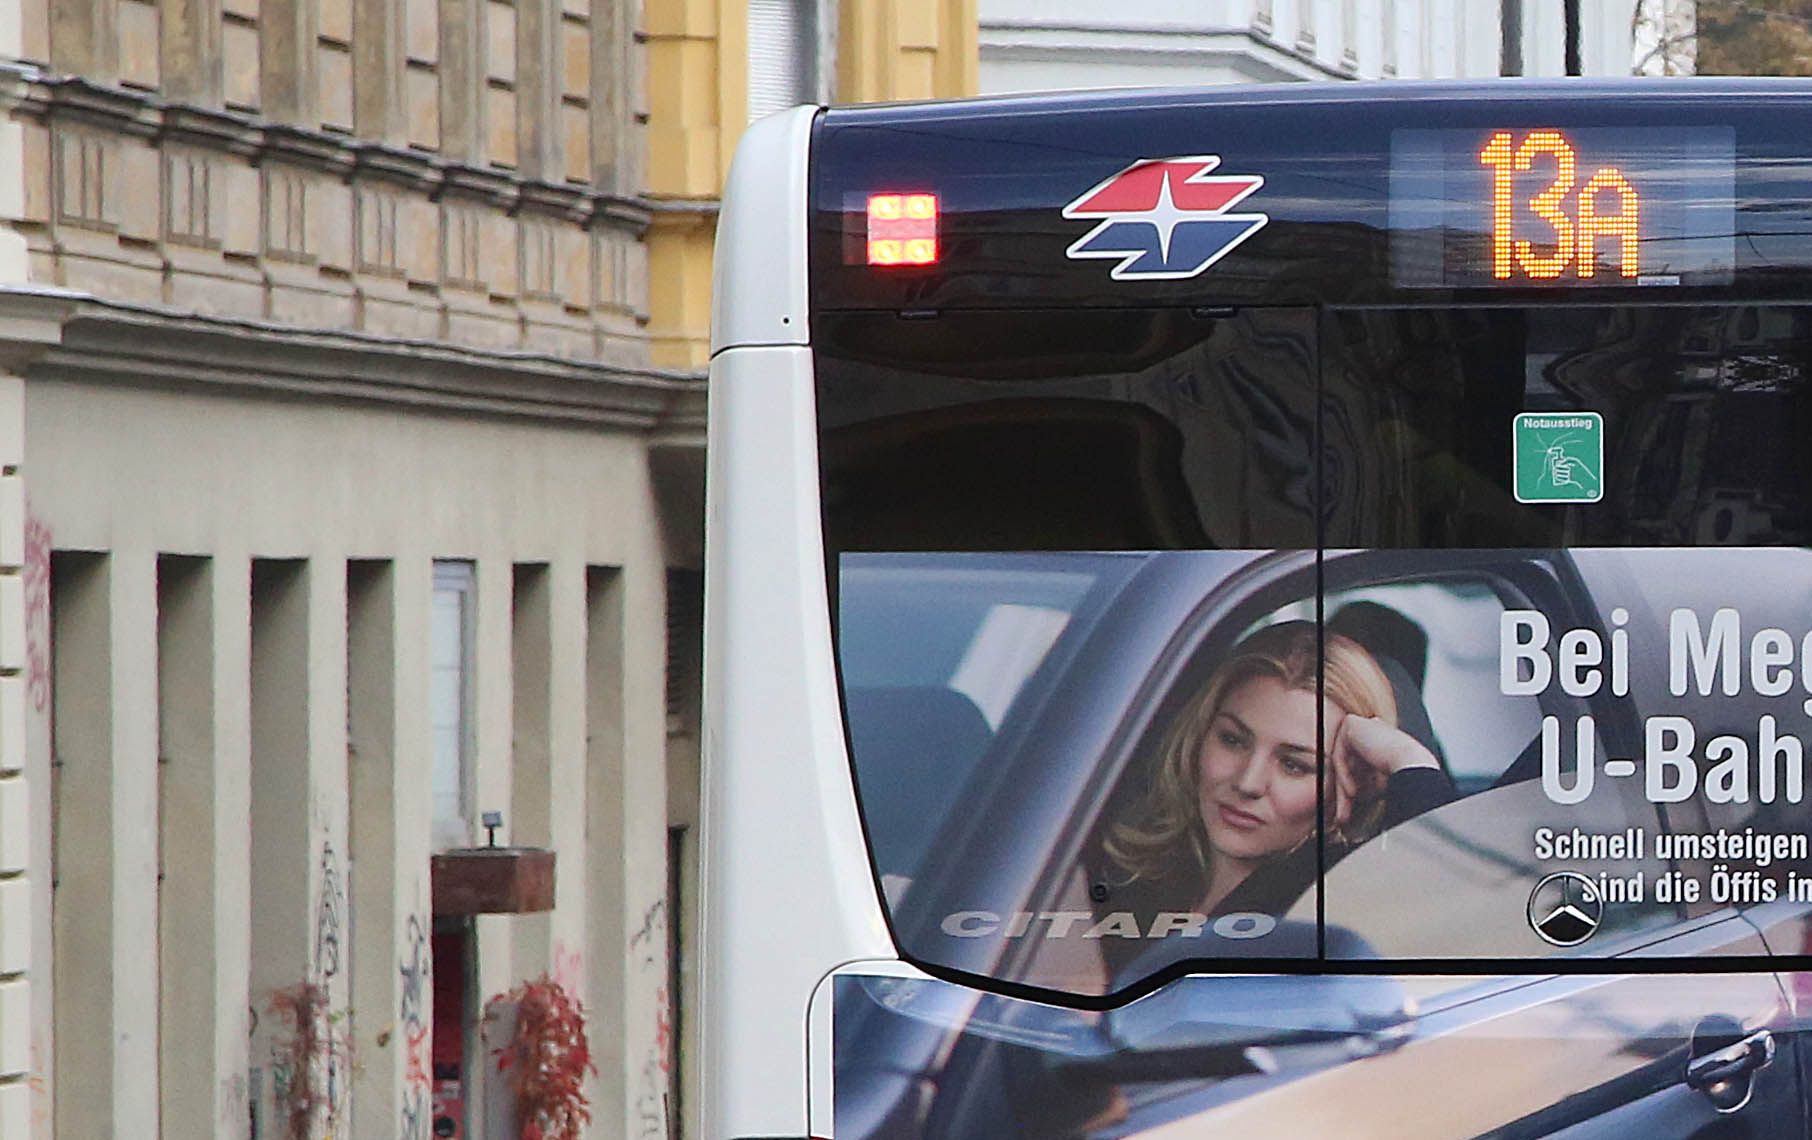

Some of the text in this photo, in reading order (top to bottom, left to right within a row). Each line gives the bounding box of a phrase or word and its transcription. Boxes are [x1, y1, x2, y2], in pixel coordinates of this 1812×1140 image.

[1479, 131, 1641, 280] 13A
[1523, 417, 1593, 430] Notausstieg
[1500, 607, 1631, 698] Bei
[1534, 827, 1645, 860] Schnell
[1656, 827, 1808, 867] umsteigen
[1655, 871, 1701, 903] die
[1711, 864, 1777, 903] Öffis
[940, 911, 1277, 938] CITARO
